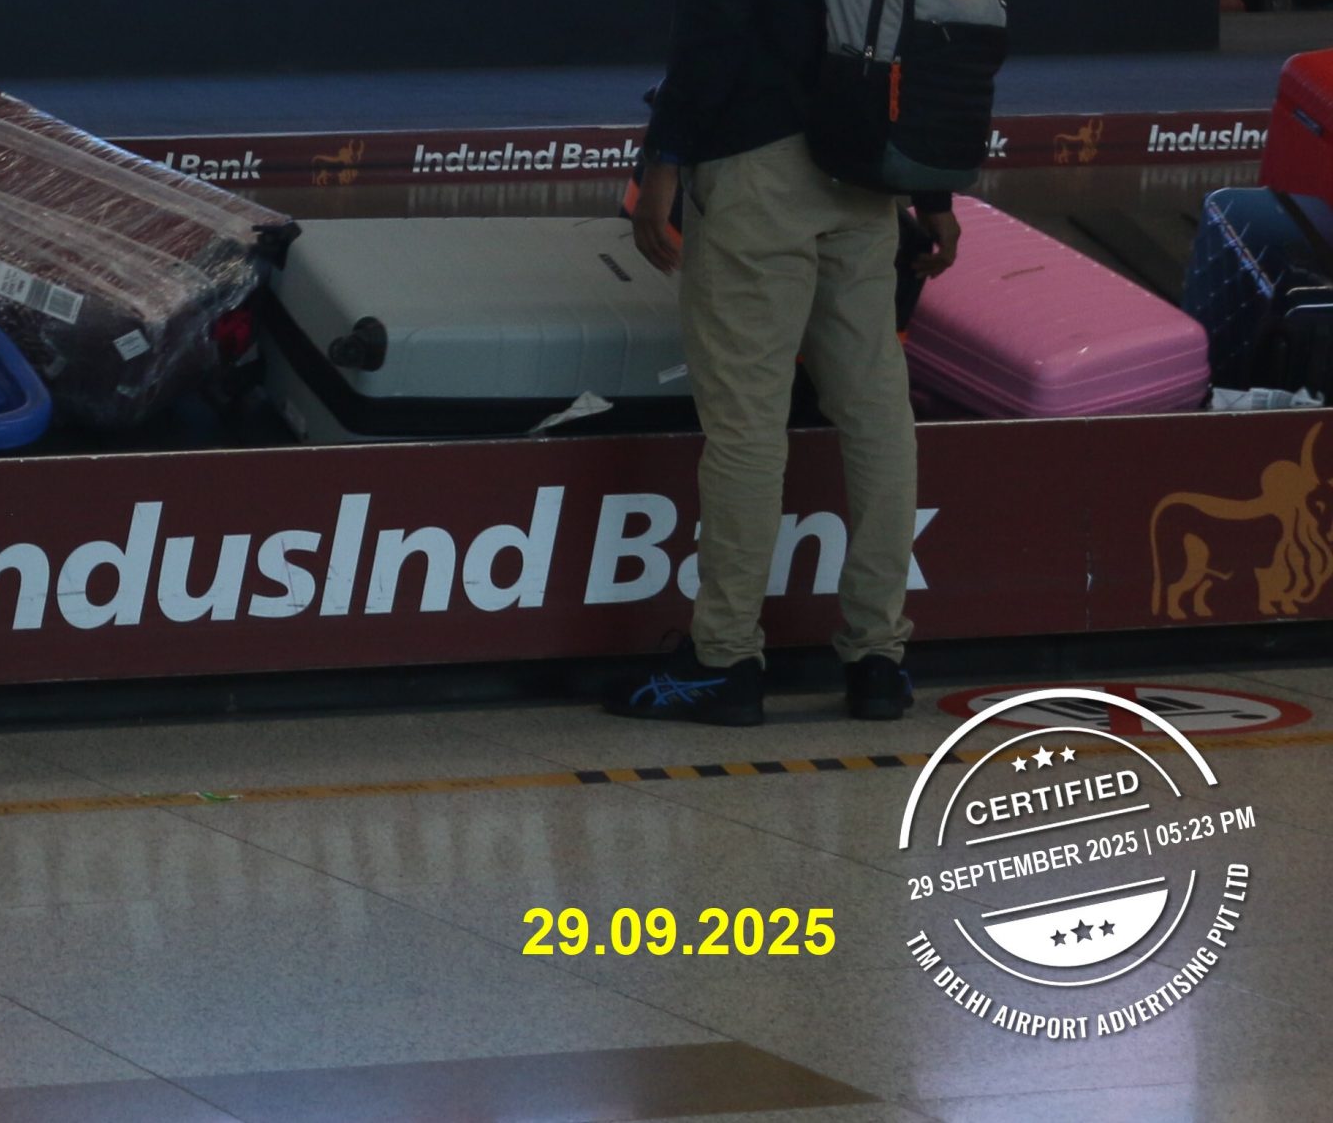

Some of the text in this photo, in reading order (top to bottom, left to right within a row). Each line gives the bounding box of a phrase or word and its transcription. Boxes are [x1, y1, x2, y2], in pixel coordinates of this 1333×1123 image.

[179, 149, 263, 182] Bank
[412, 138, 641, 174] IndusInd Bank
